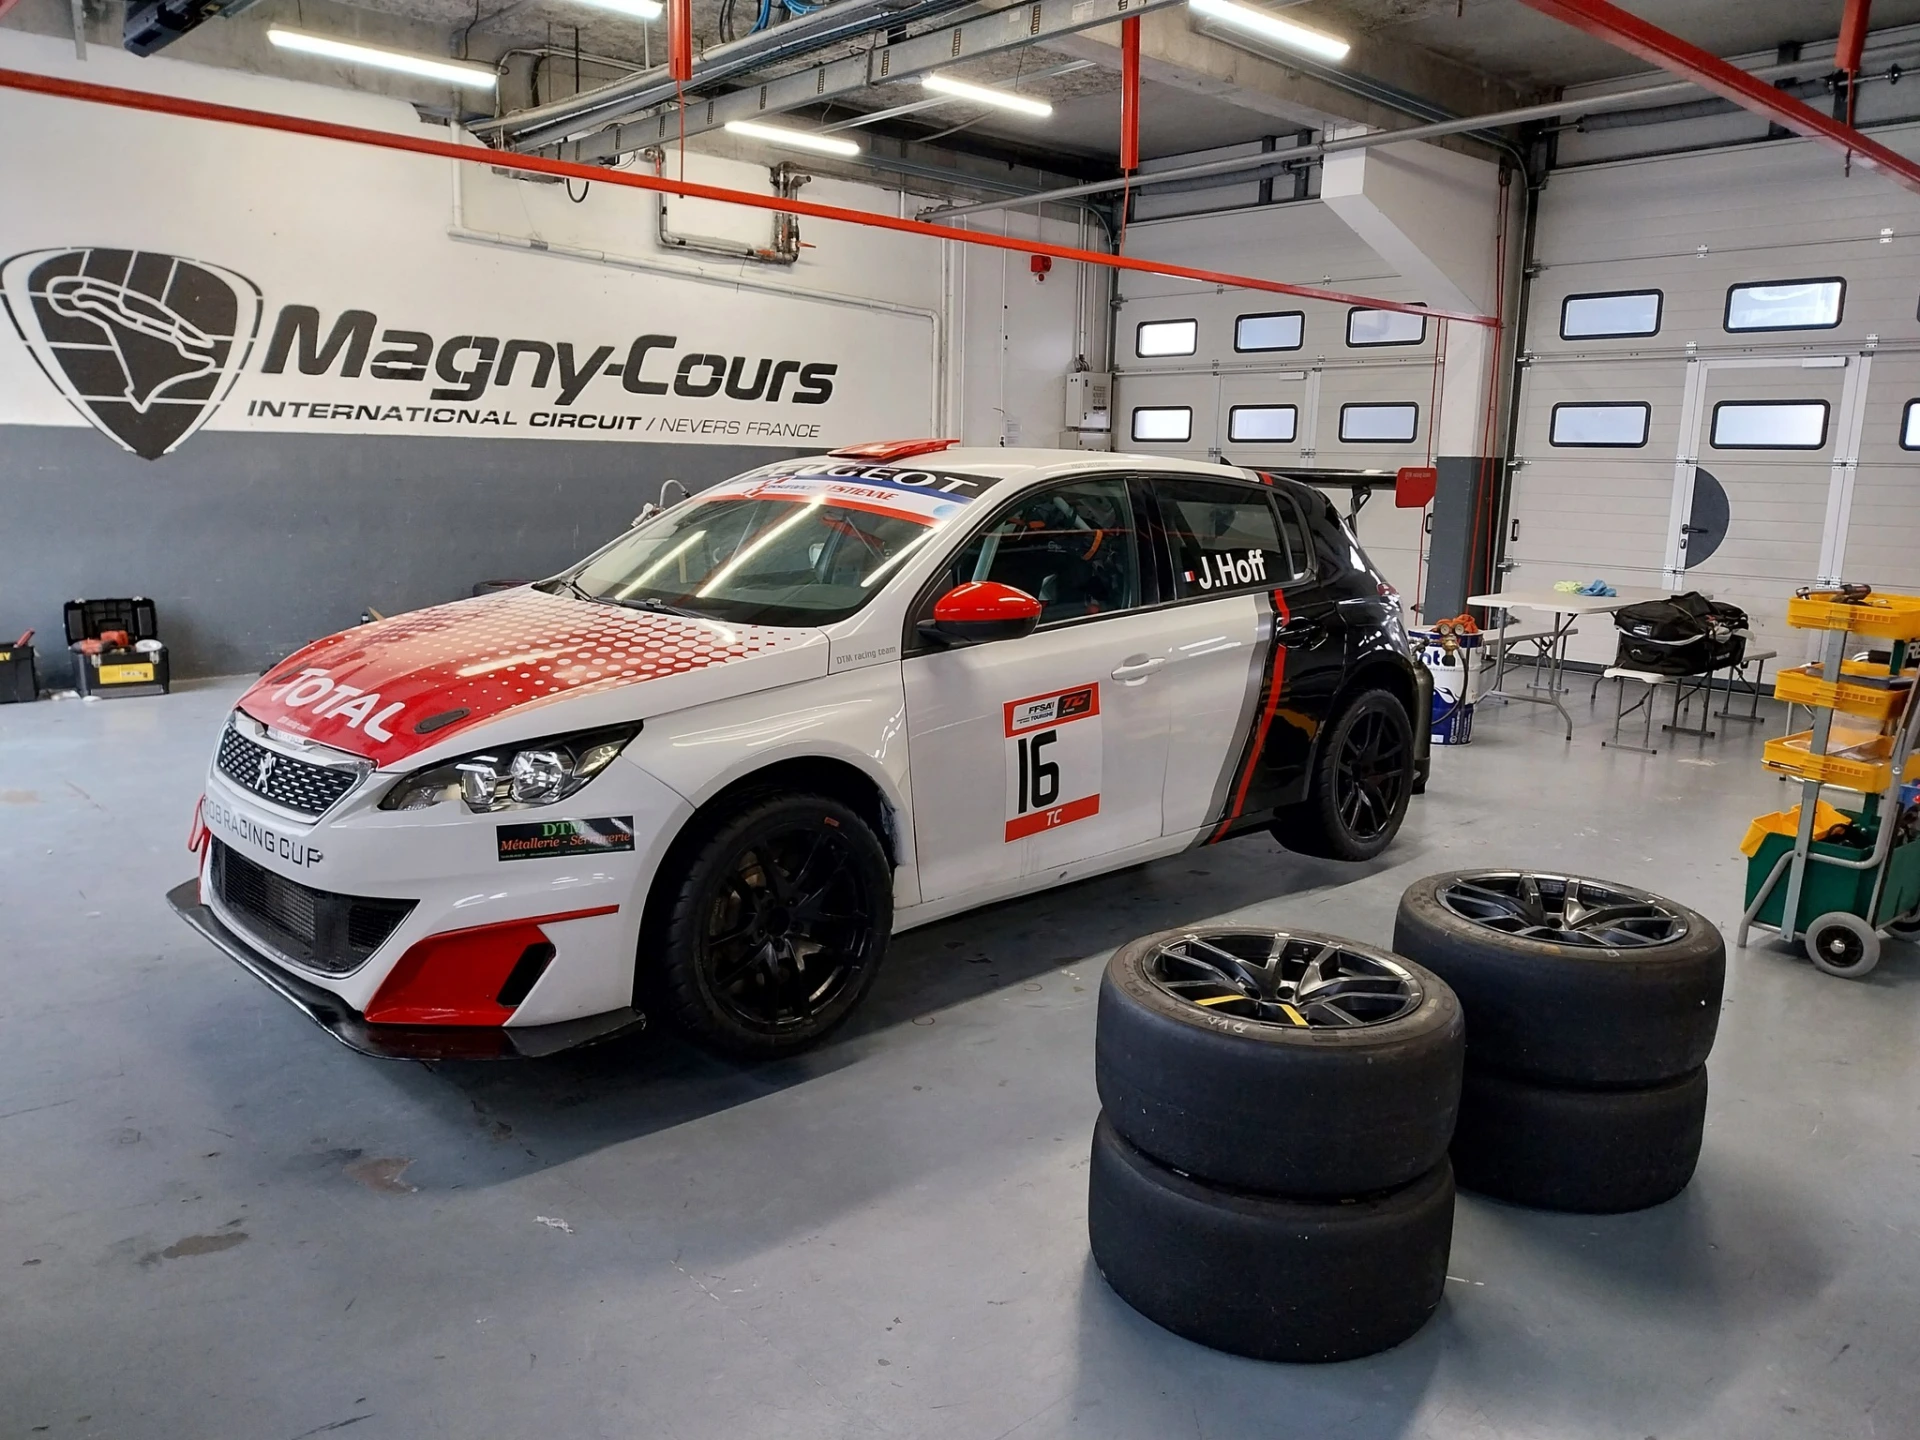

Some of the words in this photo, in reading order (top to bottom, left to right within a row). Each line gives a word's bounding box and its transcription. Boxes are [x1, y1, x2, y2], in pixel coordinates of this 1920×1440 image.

[261, 304, 837, 405] Magny-Cours
[247, 400, 517, 425] INTERNATIONAL
[529, 412, 641, 431] CIRCUIT
[660, 417, 740, 435] NEVERS
[746, 422, 821, 438] FRANCE
[1199, 549, 1267, 589] J.Hoff
[837, 654, 853, 665] DTM
[854, 650, 877, 659] racing
[878, 646, 897, 656] team
[271, 668, 405, 743] TOTAL
[1018, 729, 1060, 815] 16
[542, 819, 586, 837] DTM
[1046, 808, 1063, 827] TC
[223, 809, 275, 853] RACING
[279, 837, 322, 869] CUP
[500, 836, 560, 852] Métallerie
